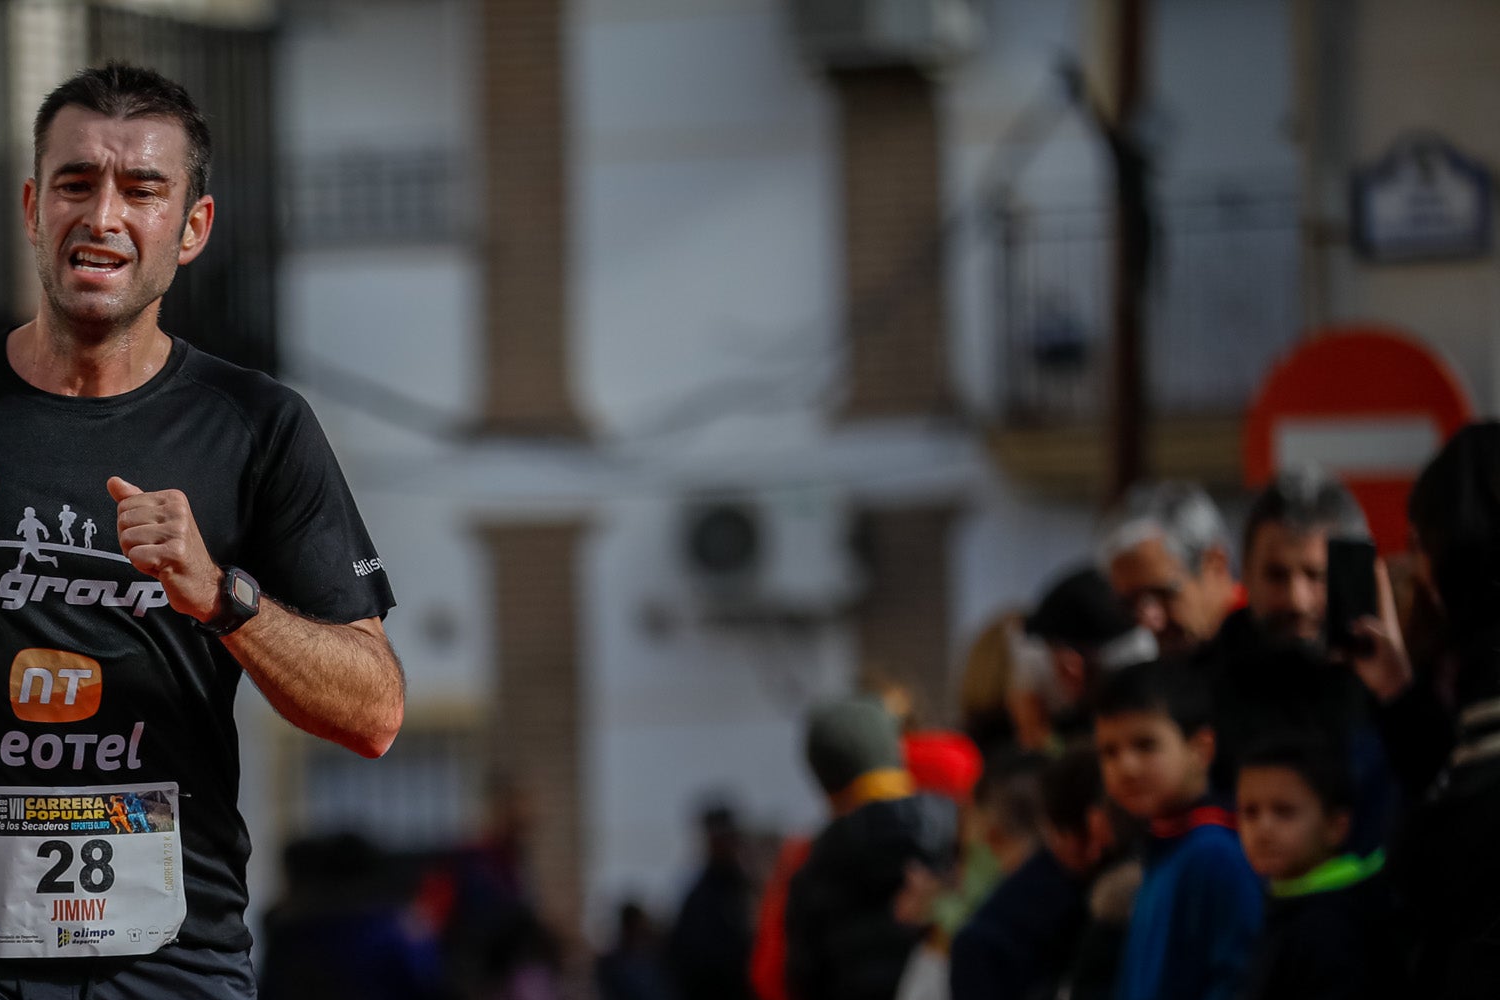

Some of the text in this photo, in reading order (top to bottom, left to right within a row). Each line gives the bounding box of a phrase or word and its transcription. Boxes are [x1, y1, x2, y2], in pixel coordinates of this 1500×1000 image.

[9, 798, 24, 819] VII
[25, 797, 105, 810] CARRERA
[26, 809, 104, 820] POPULAR
[6, 821, 19, 831] los
[21, 821, 70, 831] Secaderos
[36, 839, 115, 894] 28
[164, 856, 174, 891] CARRERA
[51, 898, 107, 922] JIMMY
[73, 927, 116, 939] olimpo
